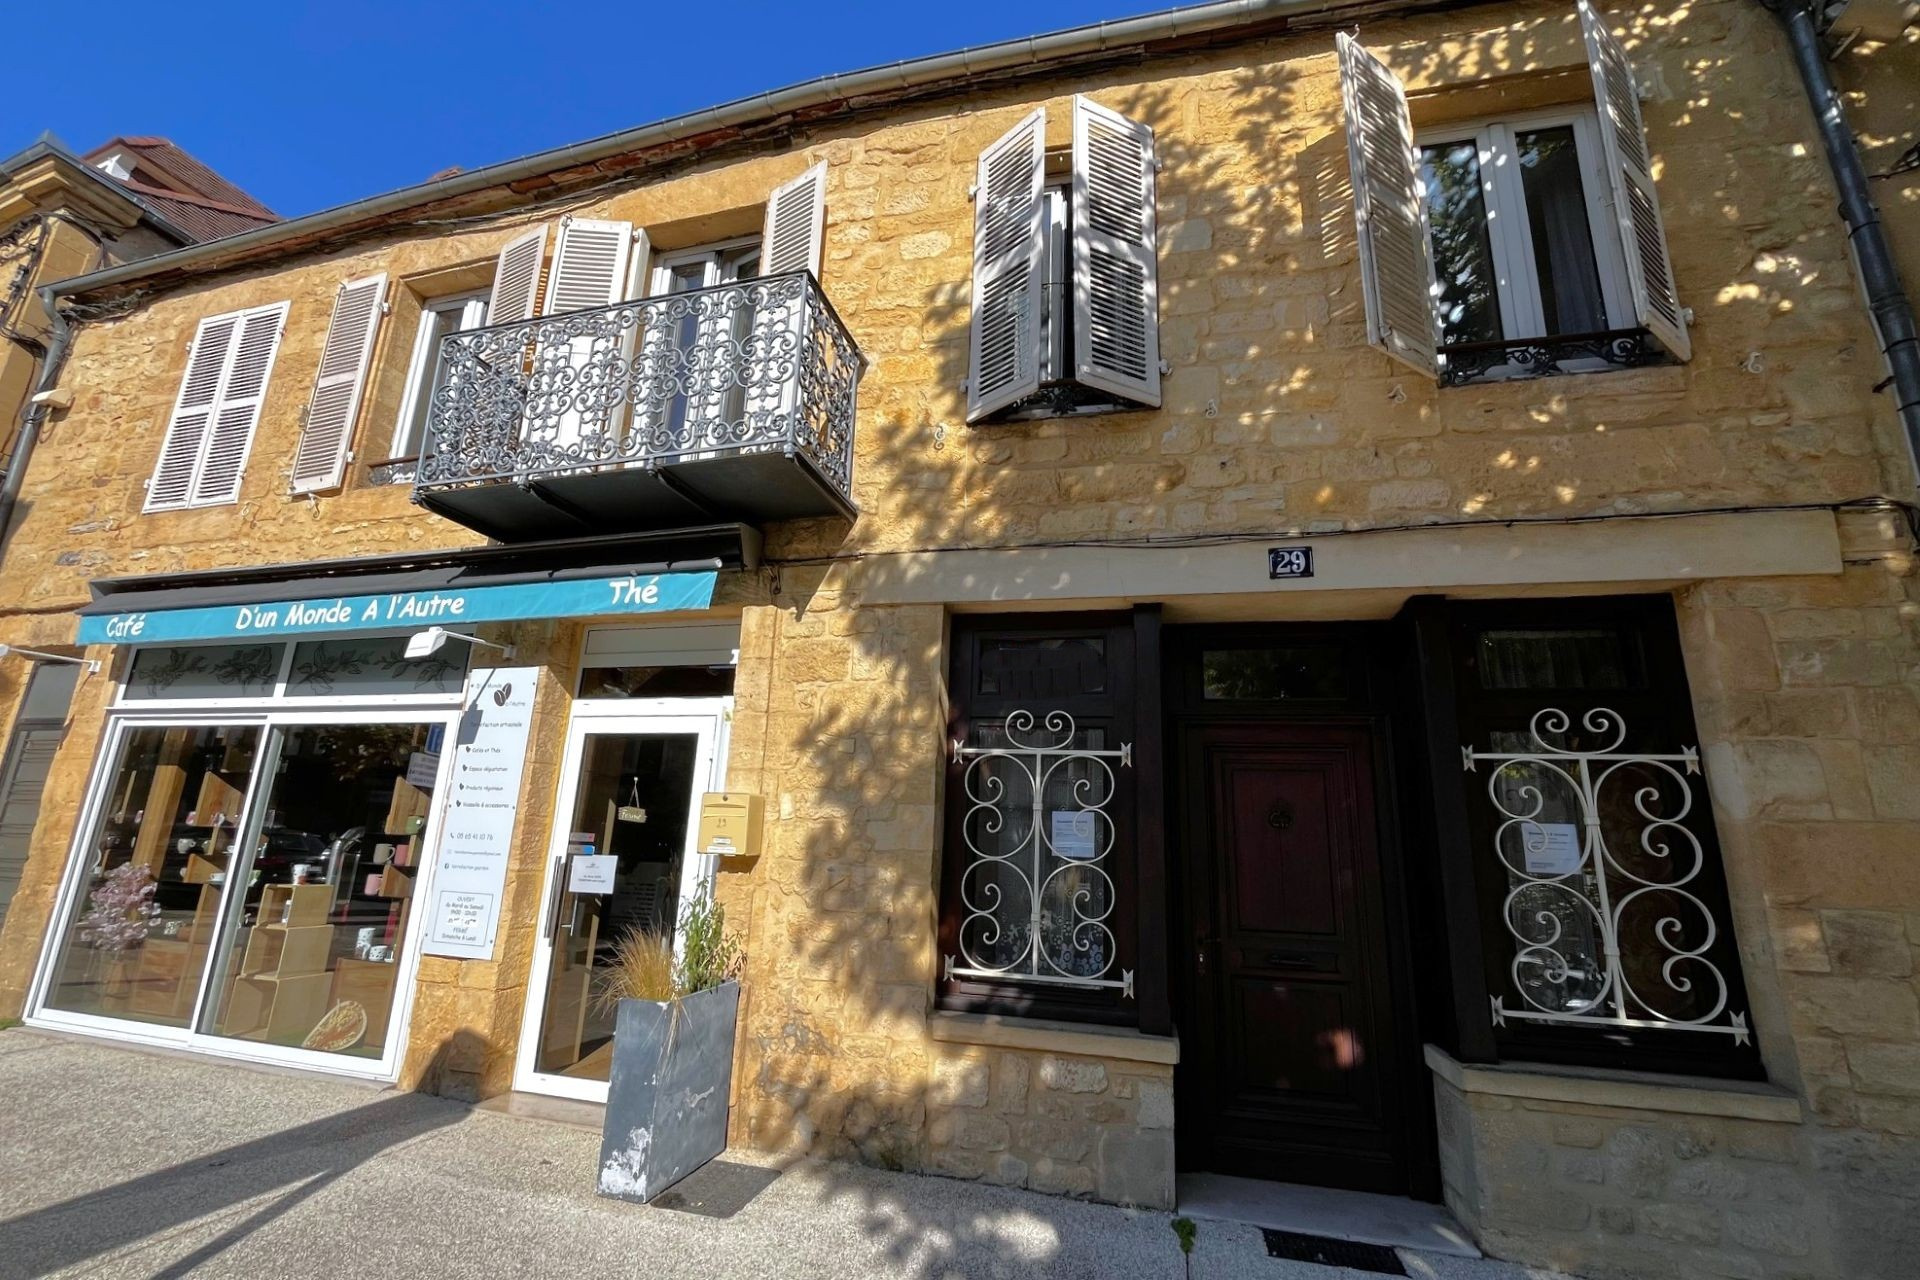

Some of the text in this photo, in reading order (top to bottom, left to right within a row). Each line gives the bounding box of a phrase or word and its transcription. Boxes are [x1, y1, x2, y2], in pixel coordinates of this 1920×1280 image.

[1276, 551, 1306, 573] 29
[609, 576, 660, 605] Thé
[235, 594, 465, 630] D'un Monde A l'Autre
[106, 614, 146, 638] Café
